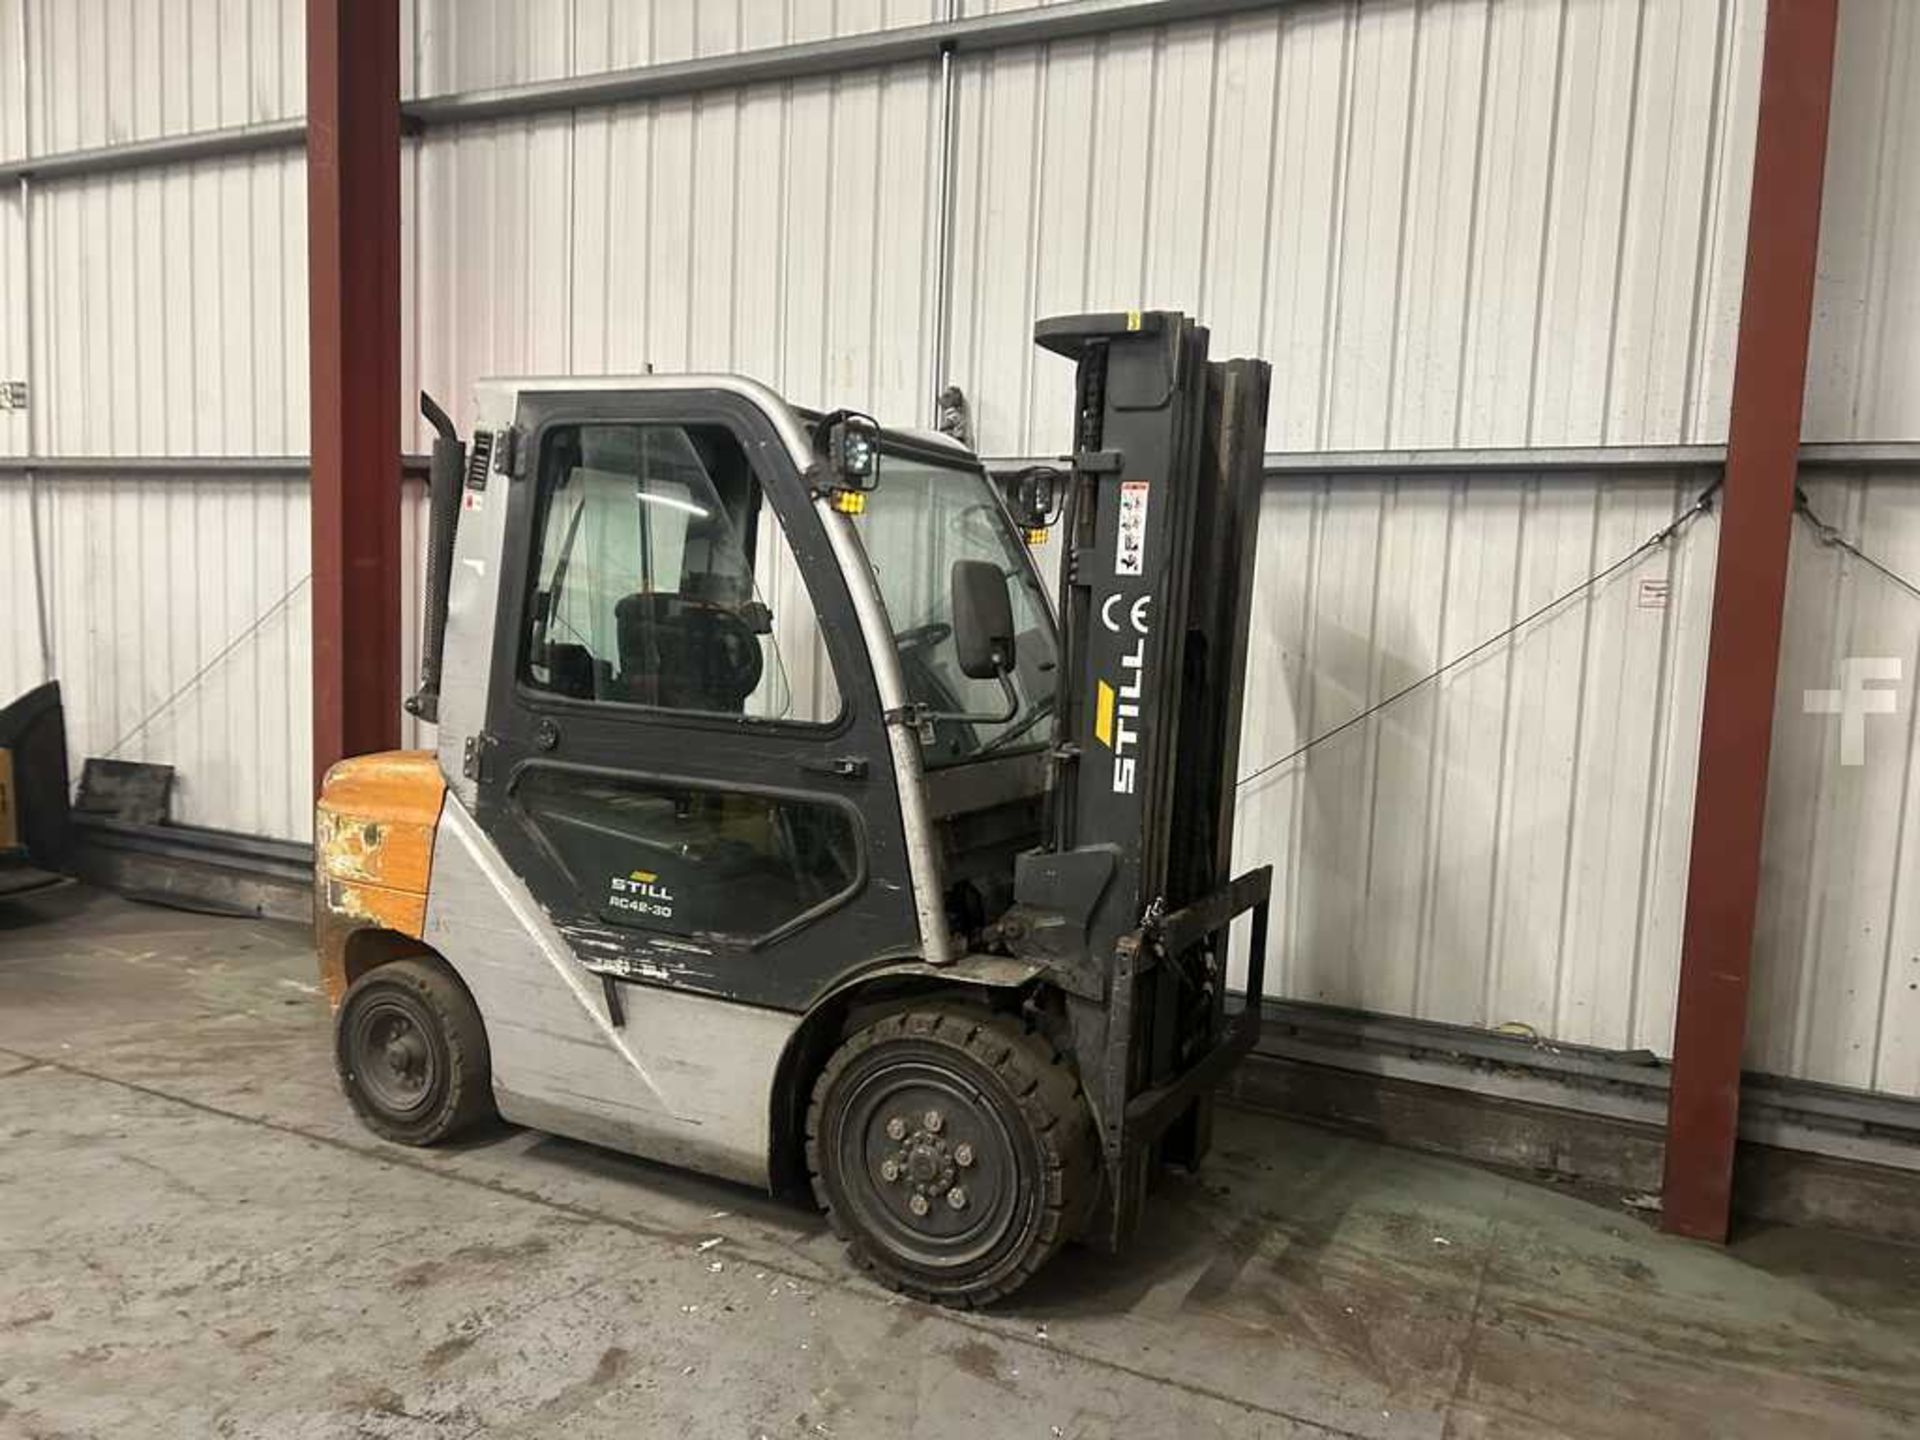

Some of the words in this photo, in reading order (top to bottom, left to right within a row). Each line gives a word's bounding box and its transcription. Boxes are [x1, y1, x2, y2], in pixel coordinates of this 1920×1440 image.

[1101, 594, 1151, 632] CE
[1113, 638, 1144, 794] STILL
[611, 877, 673, 901] STILL
